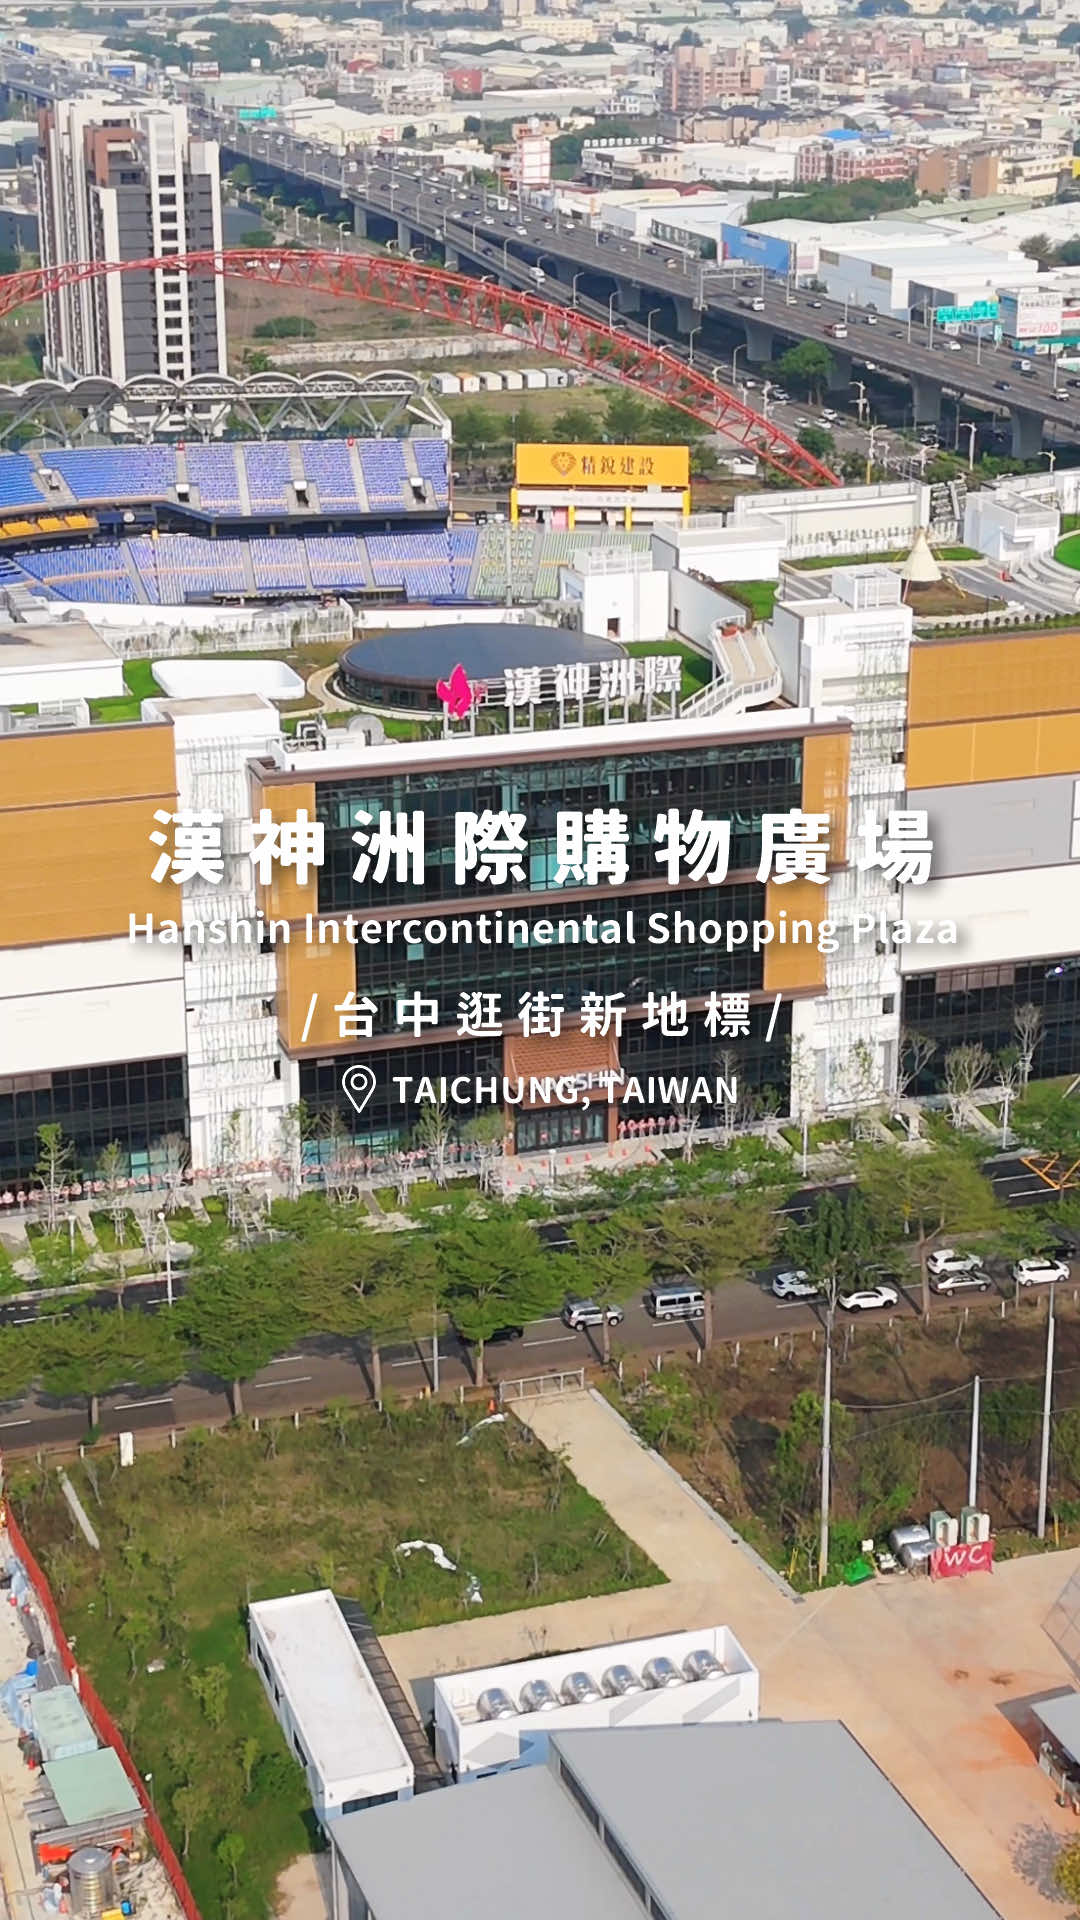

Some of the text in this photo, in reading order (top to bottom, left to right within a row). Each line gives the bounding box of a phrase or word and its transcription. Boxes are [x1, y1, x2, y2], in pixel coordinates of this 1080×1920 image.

[581, 455, 655, 476] 精銳建設
[503, 655, 682, 706] 漢神洲際
[943, 1545, 986, 1567] WC
